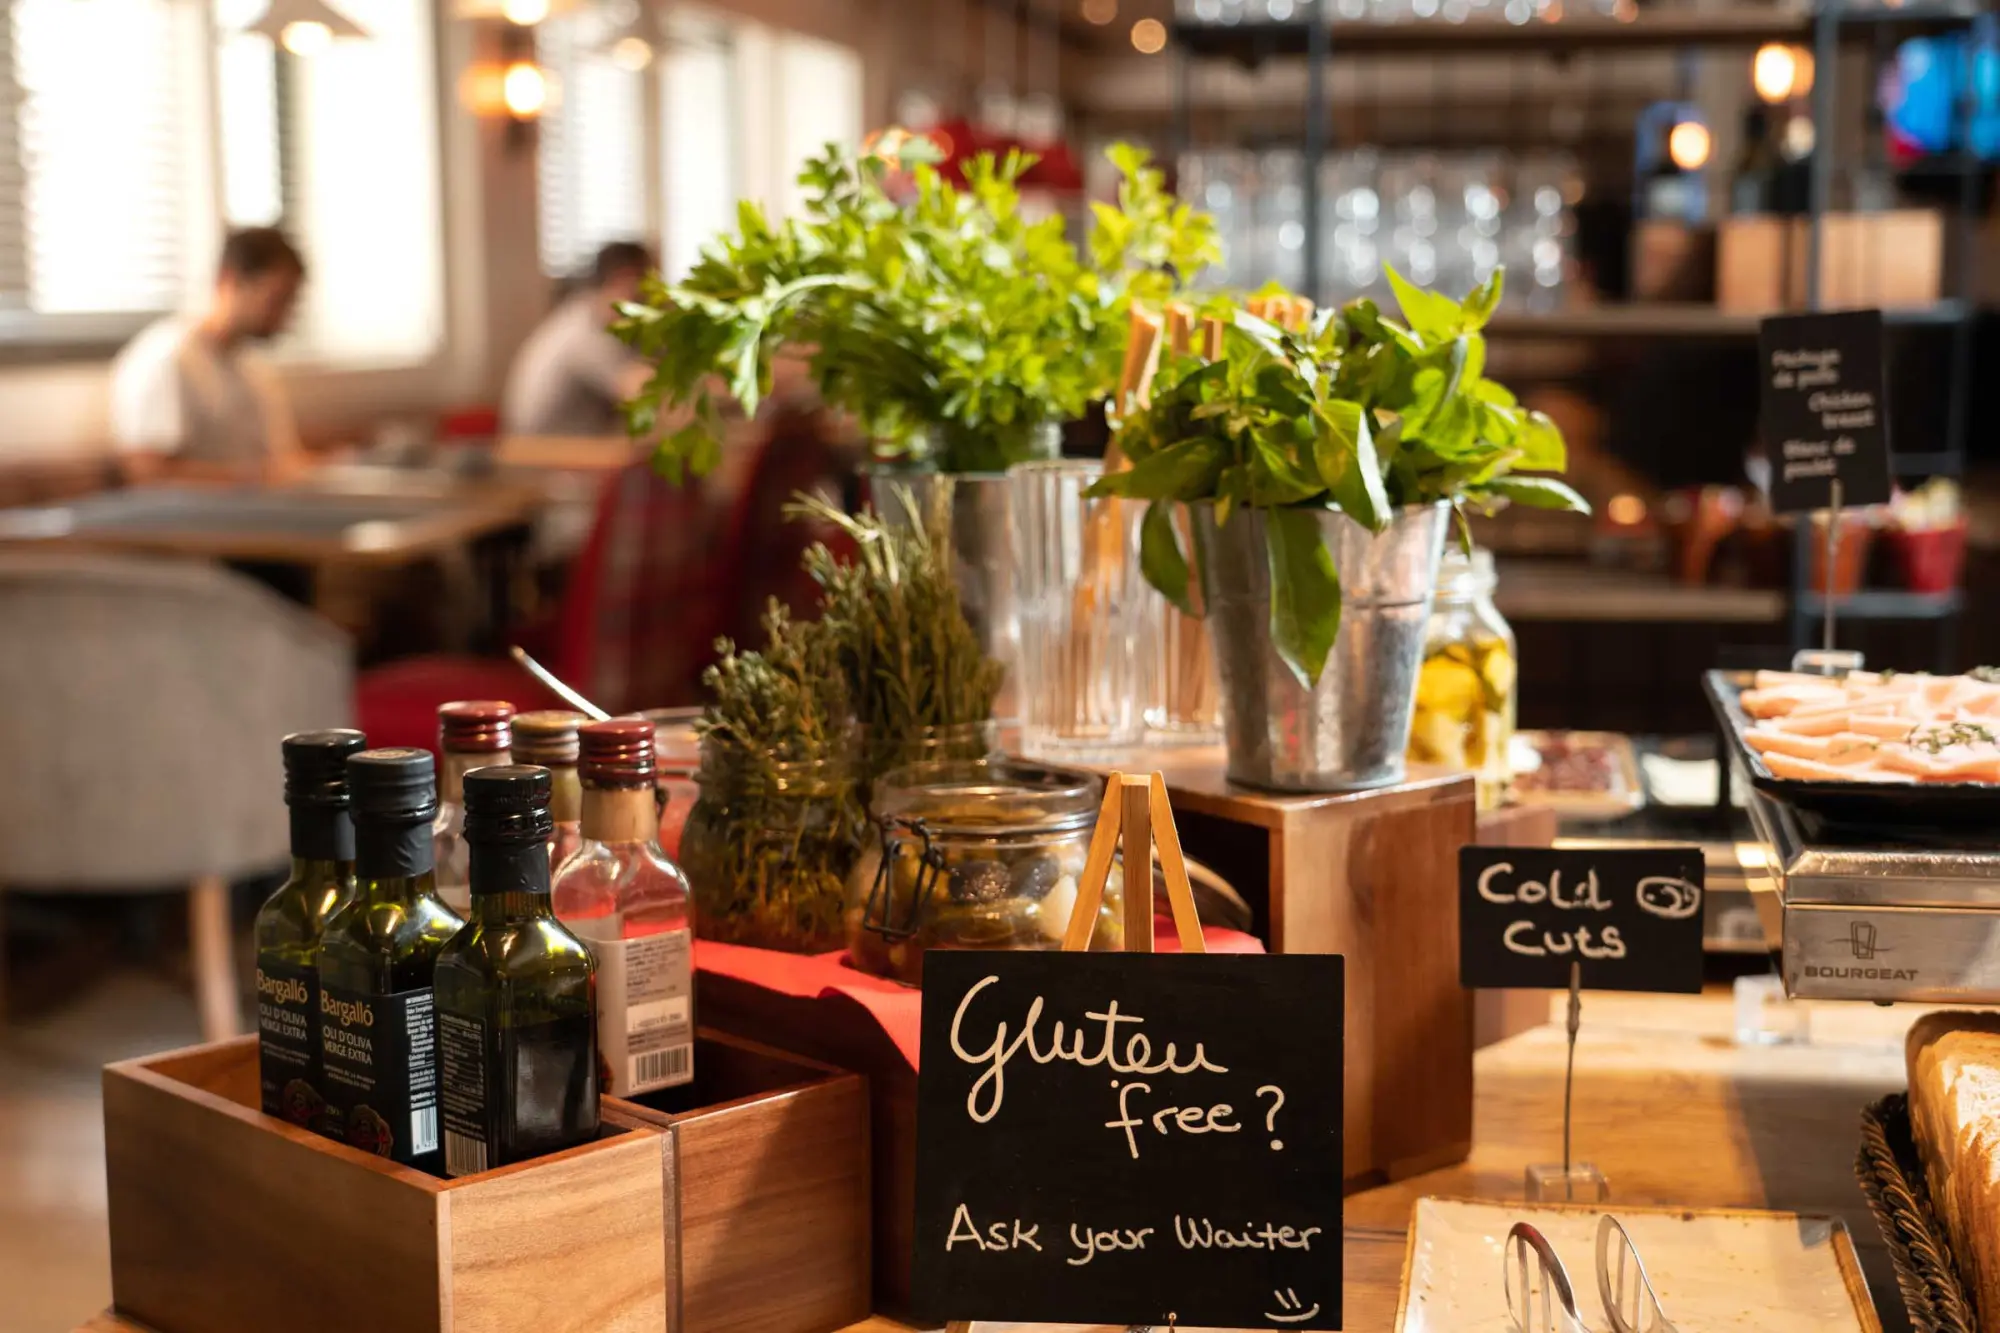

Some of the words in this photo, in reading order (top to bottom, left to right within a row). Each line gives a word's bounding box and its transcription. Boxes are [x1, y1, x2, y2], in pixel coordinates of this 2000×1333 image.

[1478, 862, 1613, 909] Cold
[1503, 920, 1627, 958] Cuts
[257, 968, 308, 1003] Bargalló
[1804, 966, 1919, 981] BOURGEAT
[260, 1003, 272, 1017] OLI
[320, 989, 374, 1027] Bargalló
[260, 1018, 281, 1035] VERGE
[283, 1022, 307, 1040] EXTRA
[323, 1025, 337, 1040] OLI
[339, 1029, 372, 1050] D'OLIVA
[324, 1040, 347, 1057] VERGE
[348, 1046, 373, 1065] EXTRA
[950, 975, 1228, 1123] Gluten
[946, 1203, 1043, 1252] Ask
[1067, 1221, 1154, 1266] your
[1174, 1214, 1321, 1252] Waiter
